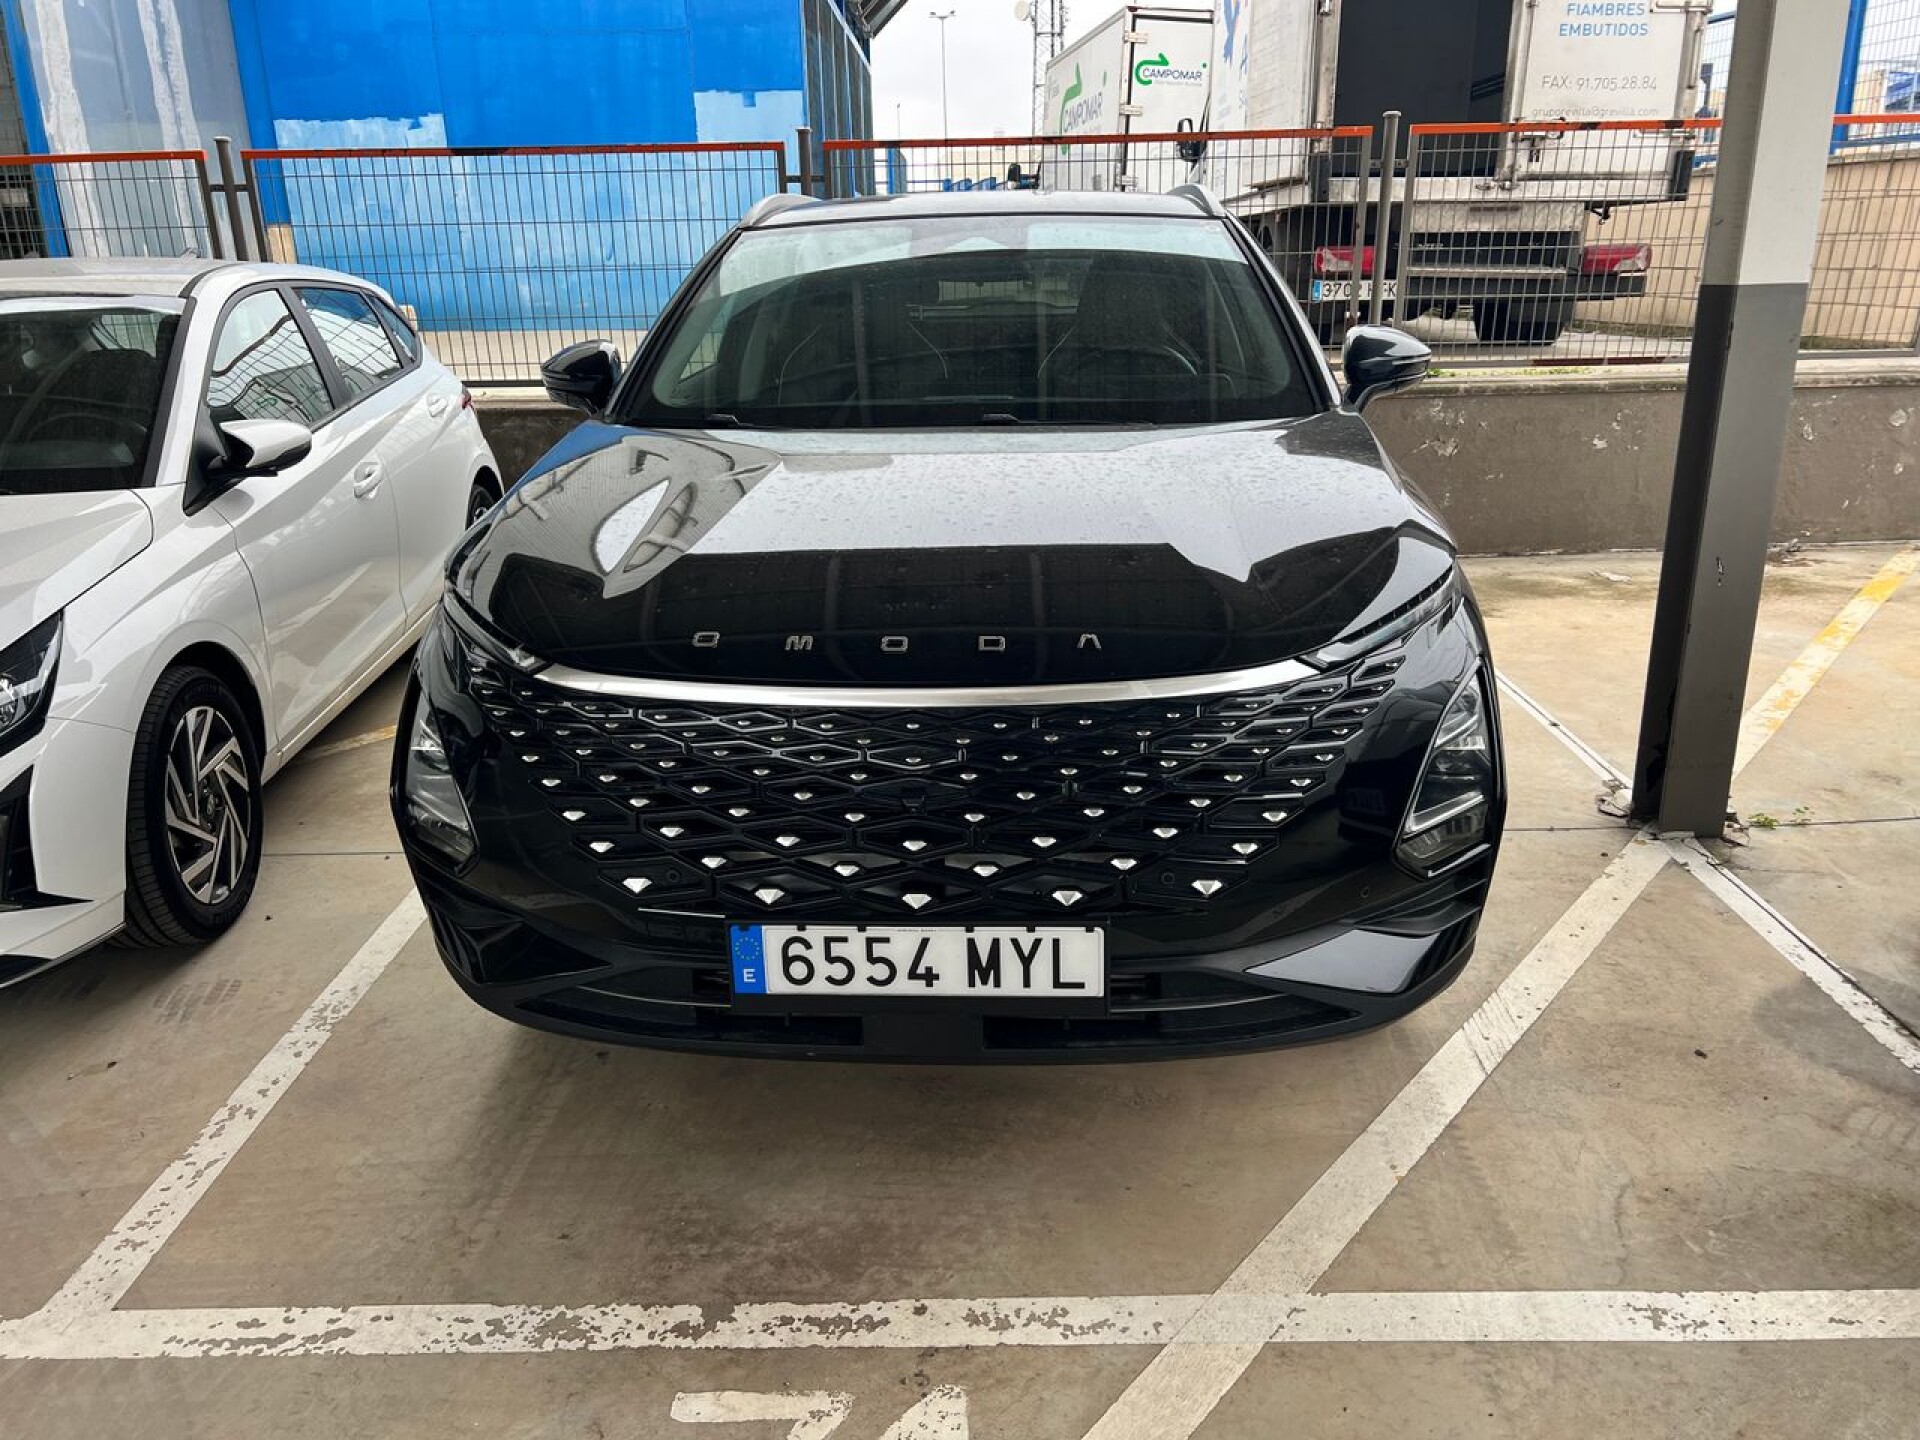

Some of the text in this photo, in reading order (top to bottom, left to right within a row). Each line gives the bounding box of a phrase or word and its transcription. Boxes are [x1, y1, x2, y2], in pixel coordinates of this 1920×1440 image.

[1566, 3, 1645, 16] FIAMBRES
[1559, 23, 1649, 37] EMBUTIDOS
[1142, 67, 1202, 81] CAMPOMAR
[1541, 75, 1657, 91] FAX: 91.705.28.84
[1063, 91, 1103, 133] CAMPOMAR
[691, 630, 1103, 652] OMODA
[743, 935, 1086, 990] E 6554 MYL
